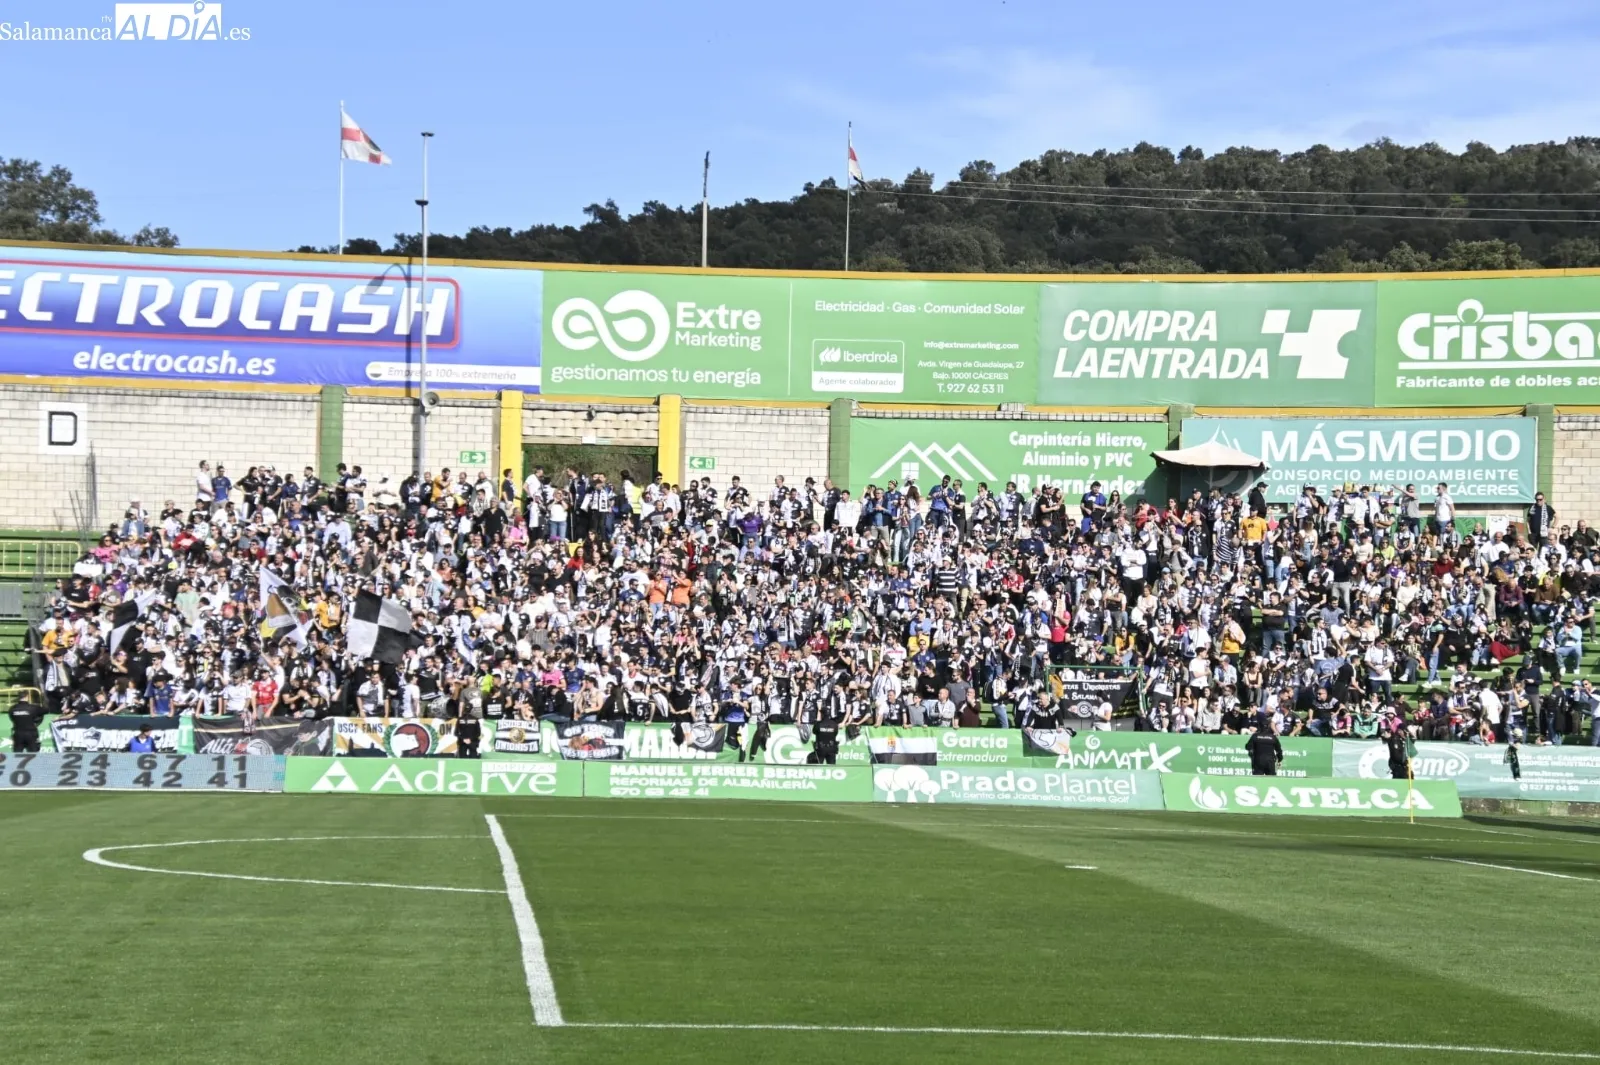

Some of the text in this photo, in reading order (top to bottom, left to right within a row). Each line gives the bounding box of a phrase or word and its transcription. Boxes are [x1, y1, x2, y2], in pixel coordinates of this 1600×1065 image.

[676, 301, 762, 330] Extre
[814, 300, 1026, 315] Electricidad Gas Comunidad Solar
[1063, 309, 1218, 342] COMPRA
[1397, 298, 1600, 360] Crisba
[675, 331, 762, 351] Marketing
[73, 346, 276, 376] electrocash.es
[843, 350, 898, 364] Iberdrola
[939, 360, 962, 370] Virgen
[1053, 347, 1270, 379] LAENTRADA
[551, 363, 761, 388] gestionamos tu energía
[818, 377, 898, 387] Agente colaborador
[972, 371, 1009, 380] CÁCERES
[1396, 374, 1600, 388] Fabricante de dobles ac
[937, 382, 1005, 393] T. 927 62 53 11
[47, 411, 78, 446] D
[1008, 430, 1148, 449] Carpintería Hierro,
[1261, 423, 1521, 463] MÁSMEDIO
[1022, 451, 1133, 470] Aluminio y PVC
[1369, 468, 1519, 481] MEDIOAMBIENTE
[1447, 480, 1519, 496] CÁCERES
[942, 731, 1008, 749] García
[0, 753, 247, 771] 7 24 67 11
[936, 751, 1008, 764] Extremadura
[57, 770, 107, 787] 23
[132, 771, 182, 788] 42
[207, 772, 248, 788] 41
[370, 761, 557, 794] Adarve
[610, 764, 847, 781] MANUEL FERRER BERMEJO
[610, 777, 817, 790] REFORMAS DE ALBAÑILERÍA
[669, 787, 689, 796] 42
[694, 787, 709, 796] 41
[940, 770, 1137, 795] Prado Plantel
[1234, 785, 1435, 810] SATELCA
